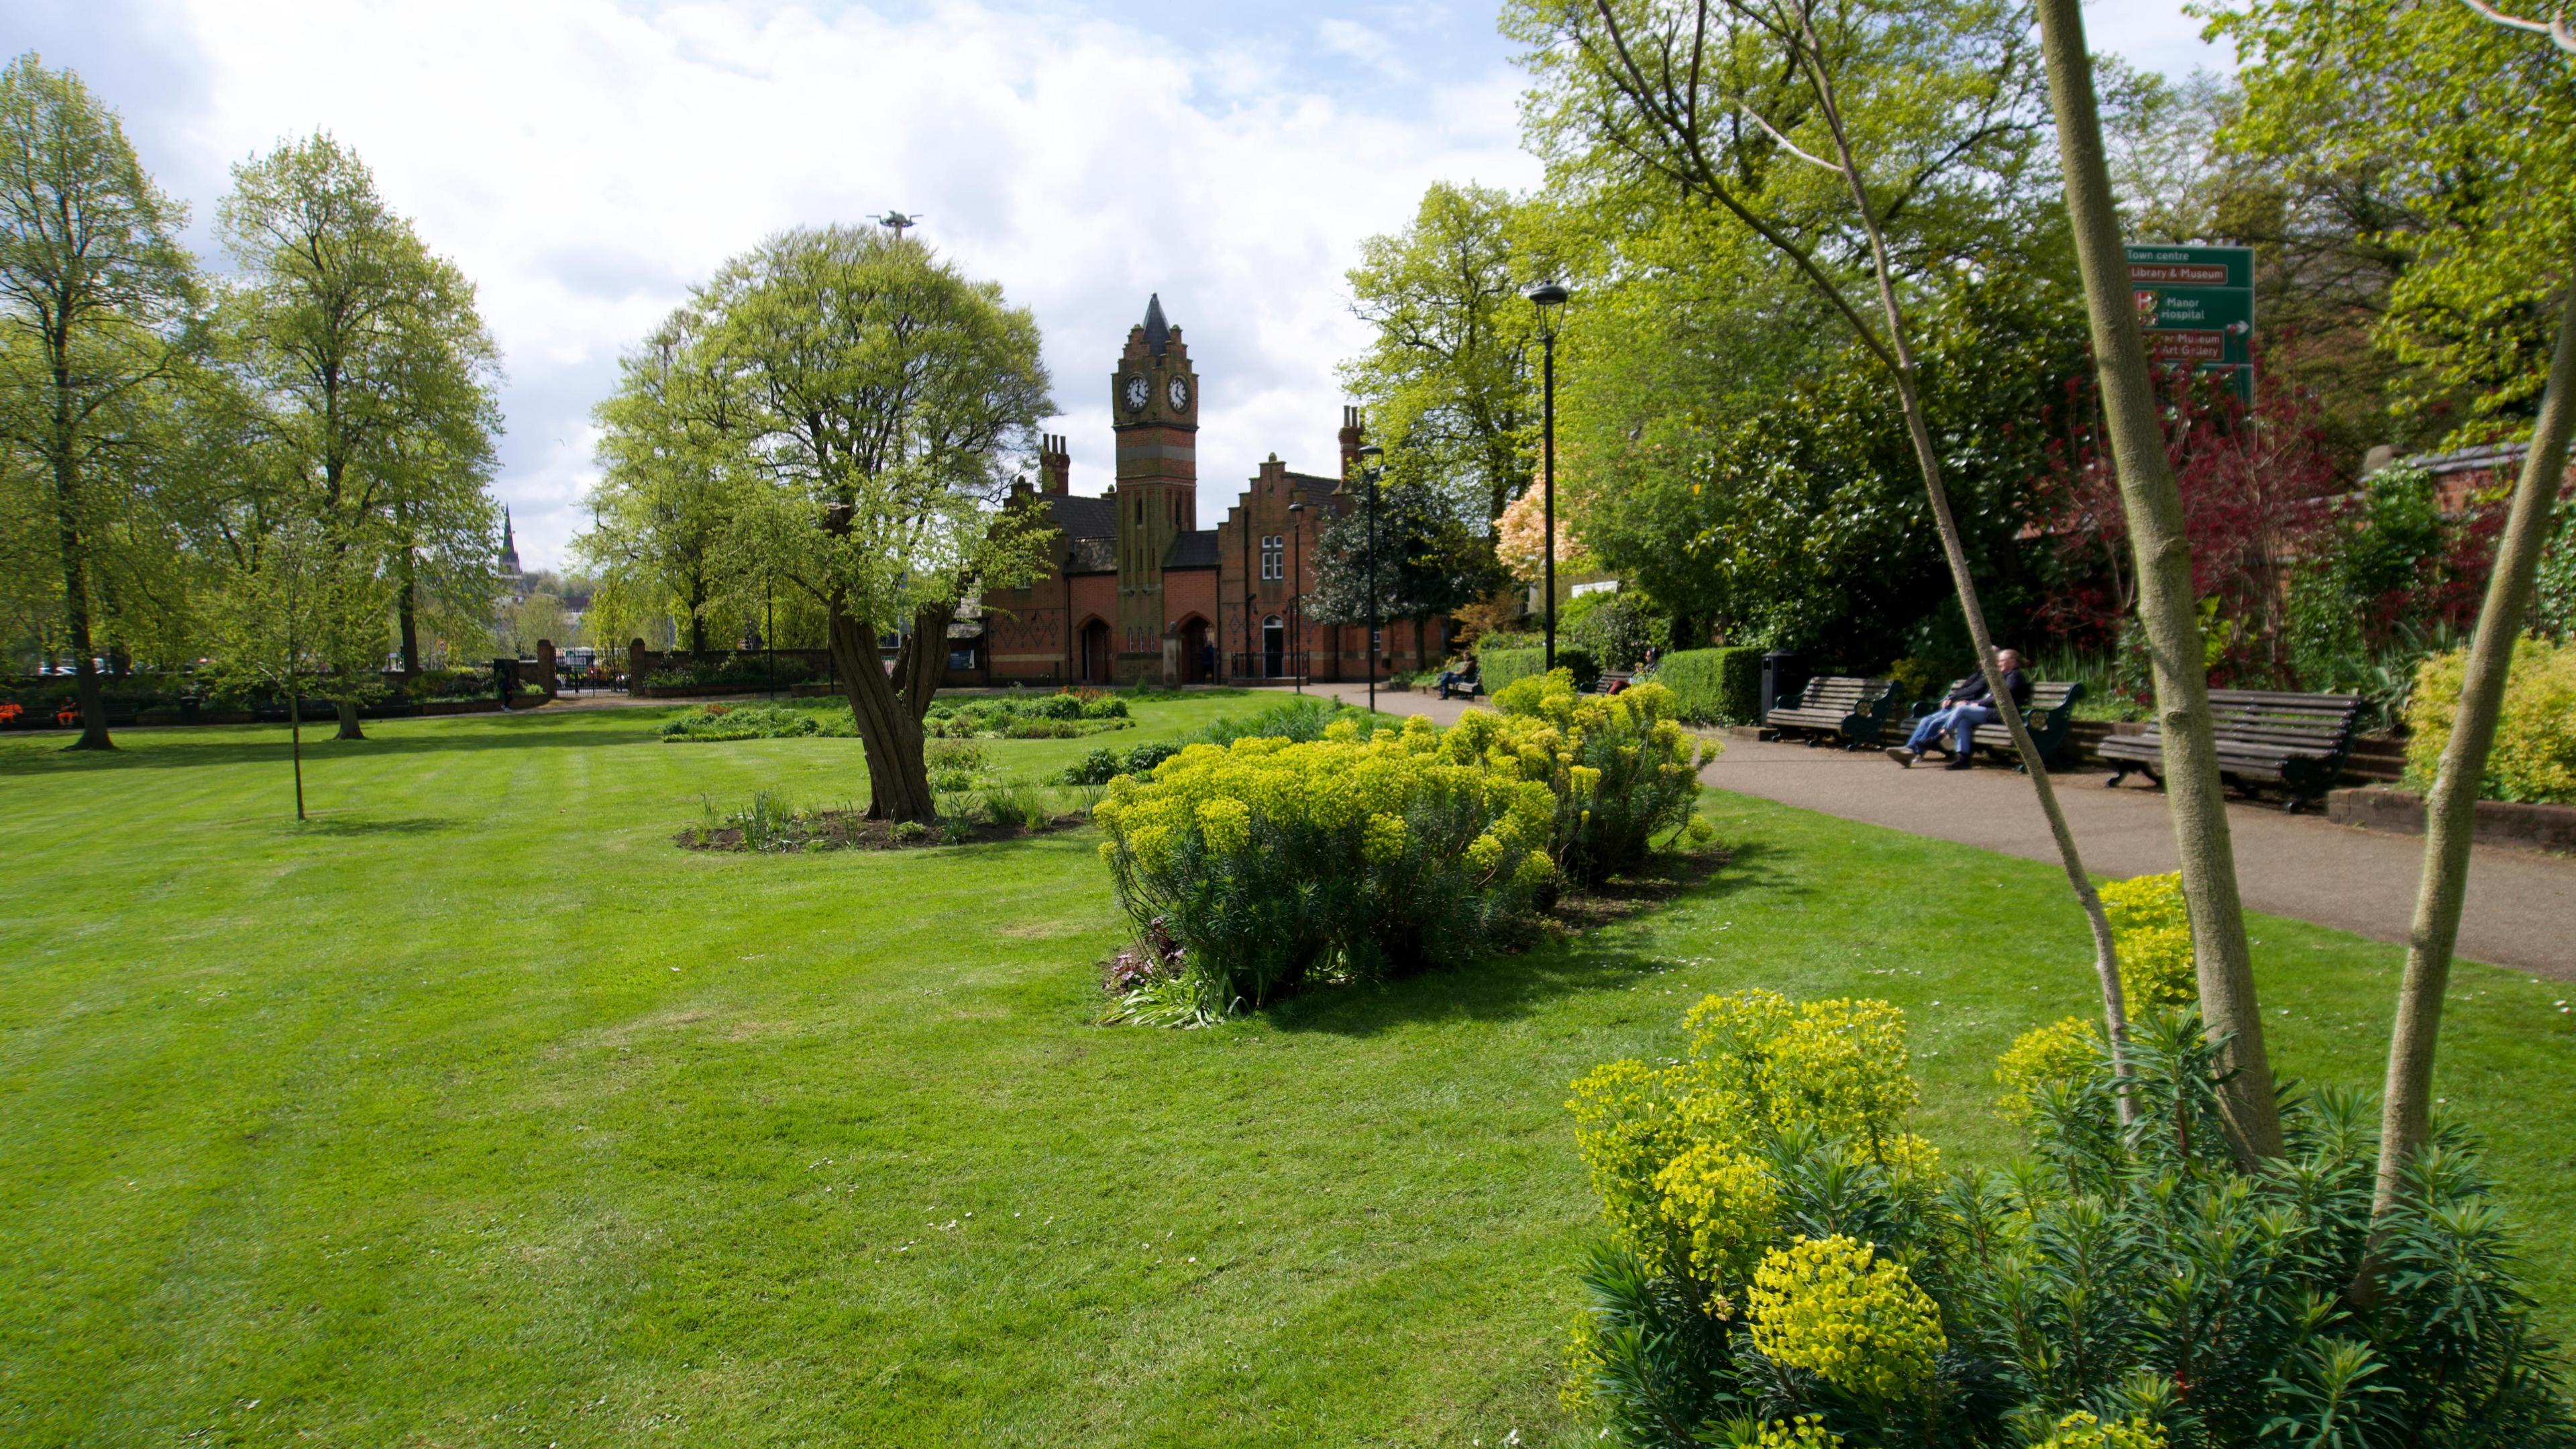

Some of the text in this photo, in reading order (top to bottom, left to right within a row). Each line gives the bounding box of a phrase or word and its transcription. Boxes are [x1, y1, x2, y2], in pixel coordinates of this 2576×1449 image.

[2127, 249, 2190, 261] Town centre
[2132, 268, 2223, 279] Library & Museum
[2167, 297, 2200, 308] Manor
[2162, 345, 2178, 355] Art
